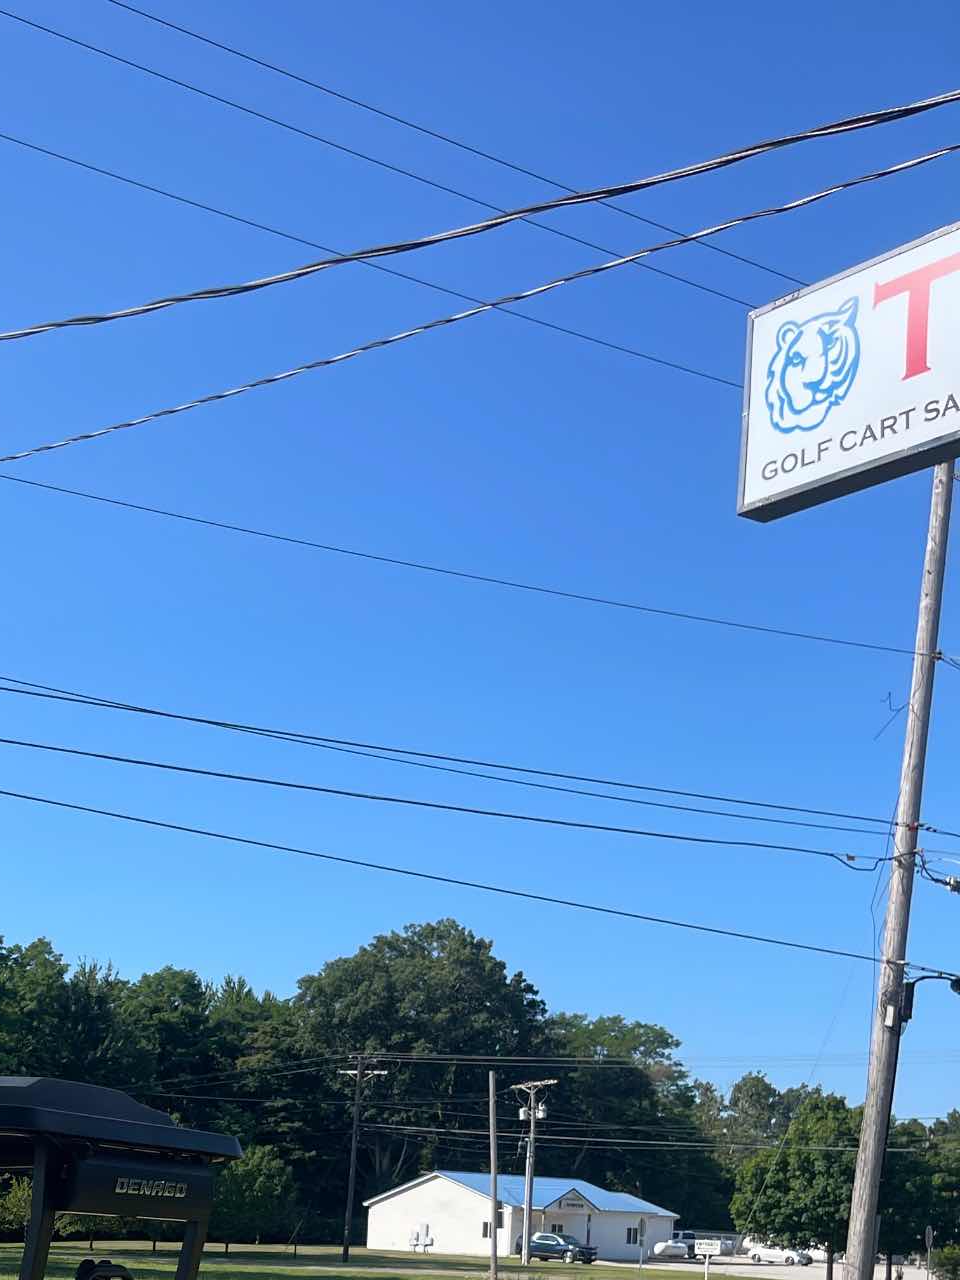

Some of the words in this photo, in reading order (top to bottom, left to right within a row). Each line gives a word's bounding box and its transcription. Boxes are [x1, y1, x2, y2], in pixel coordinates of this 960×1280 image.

[873, 251, 960, 381] T
[762, 438, 833, 481] GOLF
[840, 407, 916, 452] CART
[924, 393, 960, 422] SA
[115, 1177, 187, 1198] DENAGO
